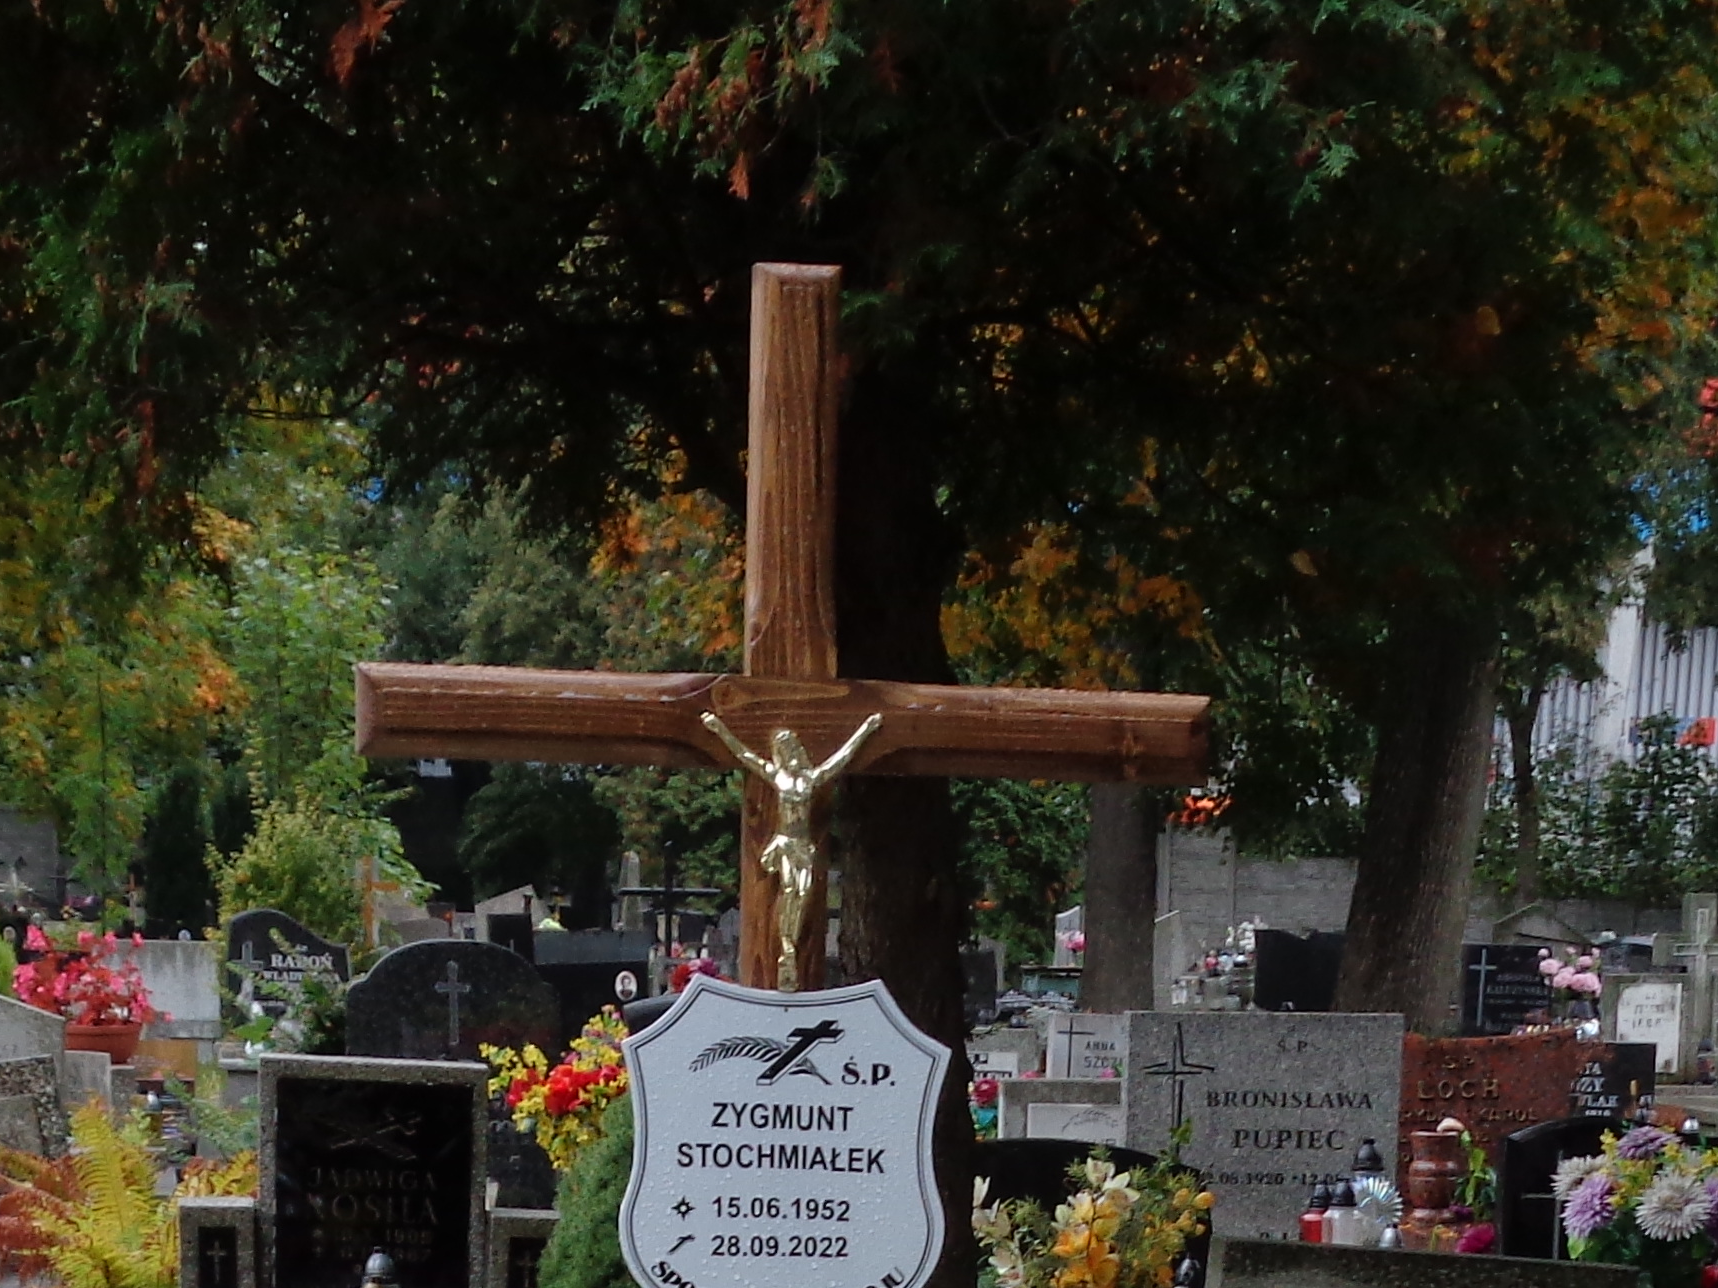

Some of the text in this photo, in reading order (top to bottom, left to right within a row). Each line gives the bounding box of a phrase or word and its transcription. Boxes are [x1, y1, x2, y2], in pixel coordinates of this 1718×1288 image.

[1205, 1089, 1374, 1111] BRONISŁAWA
[1416, 1078, 1501, 1101] LOCH
[710, 1102, 854, 1132] ZYGMUNT
[1232, 1128, 1345, 1151] PUPIEC
[676, 1142, 887, 1174] STOCHMIAŁEK
[308, 1166, 438, 1191] JADWIGA
[711, 1196, 851, 1222] 15.06.1952
[710, 1234, 850, 1258] 28.09.2022
